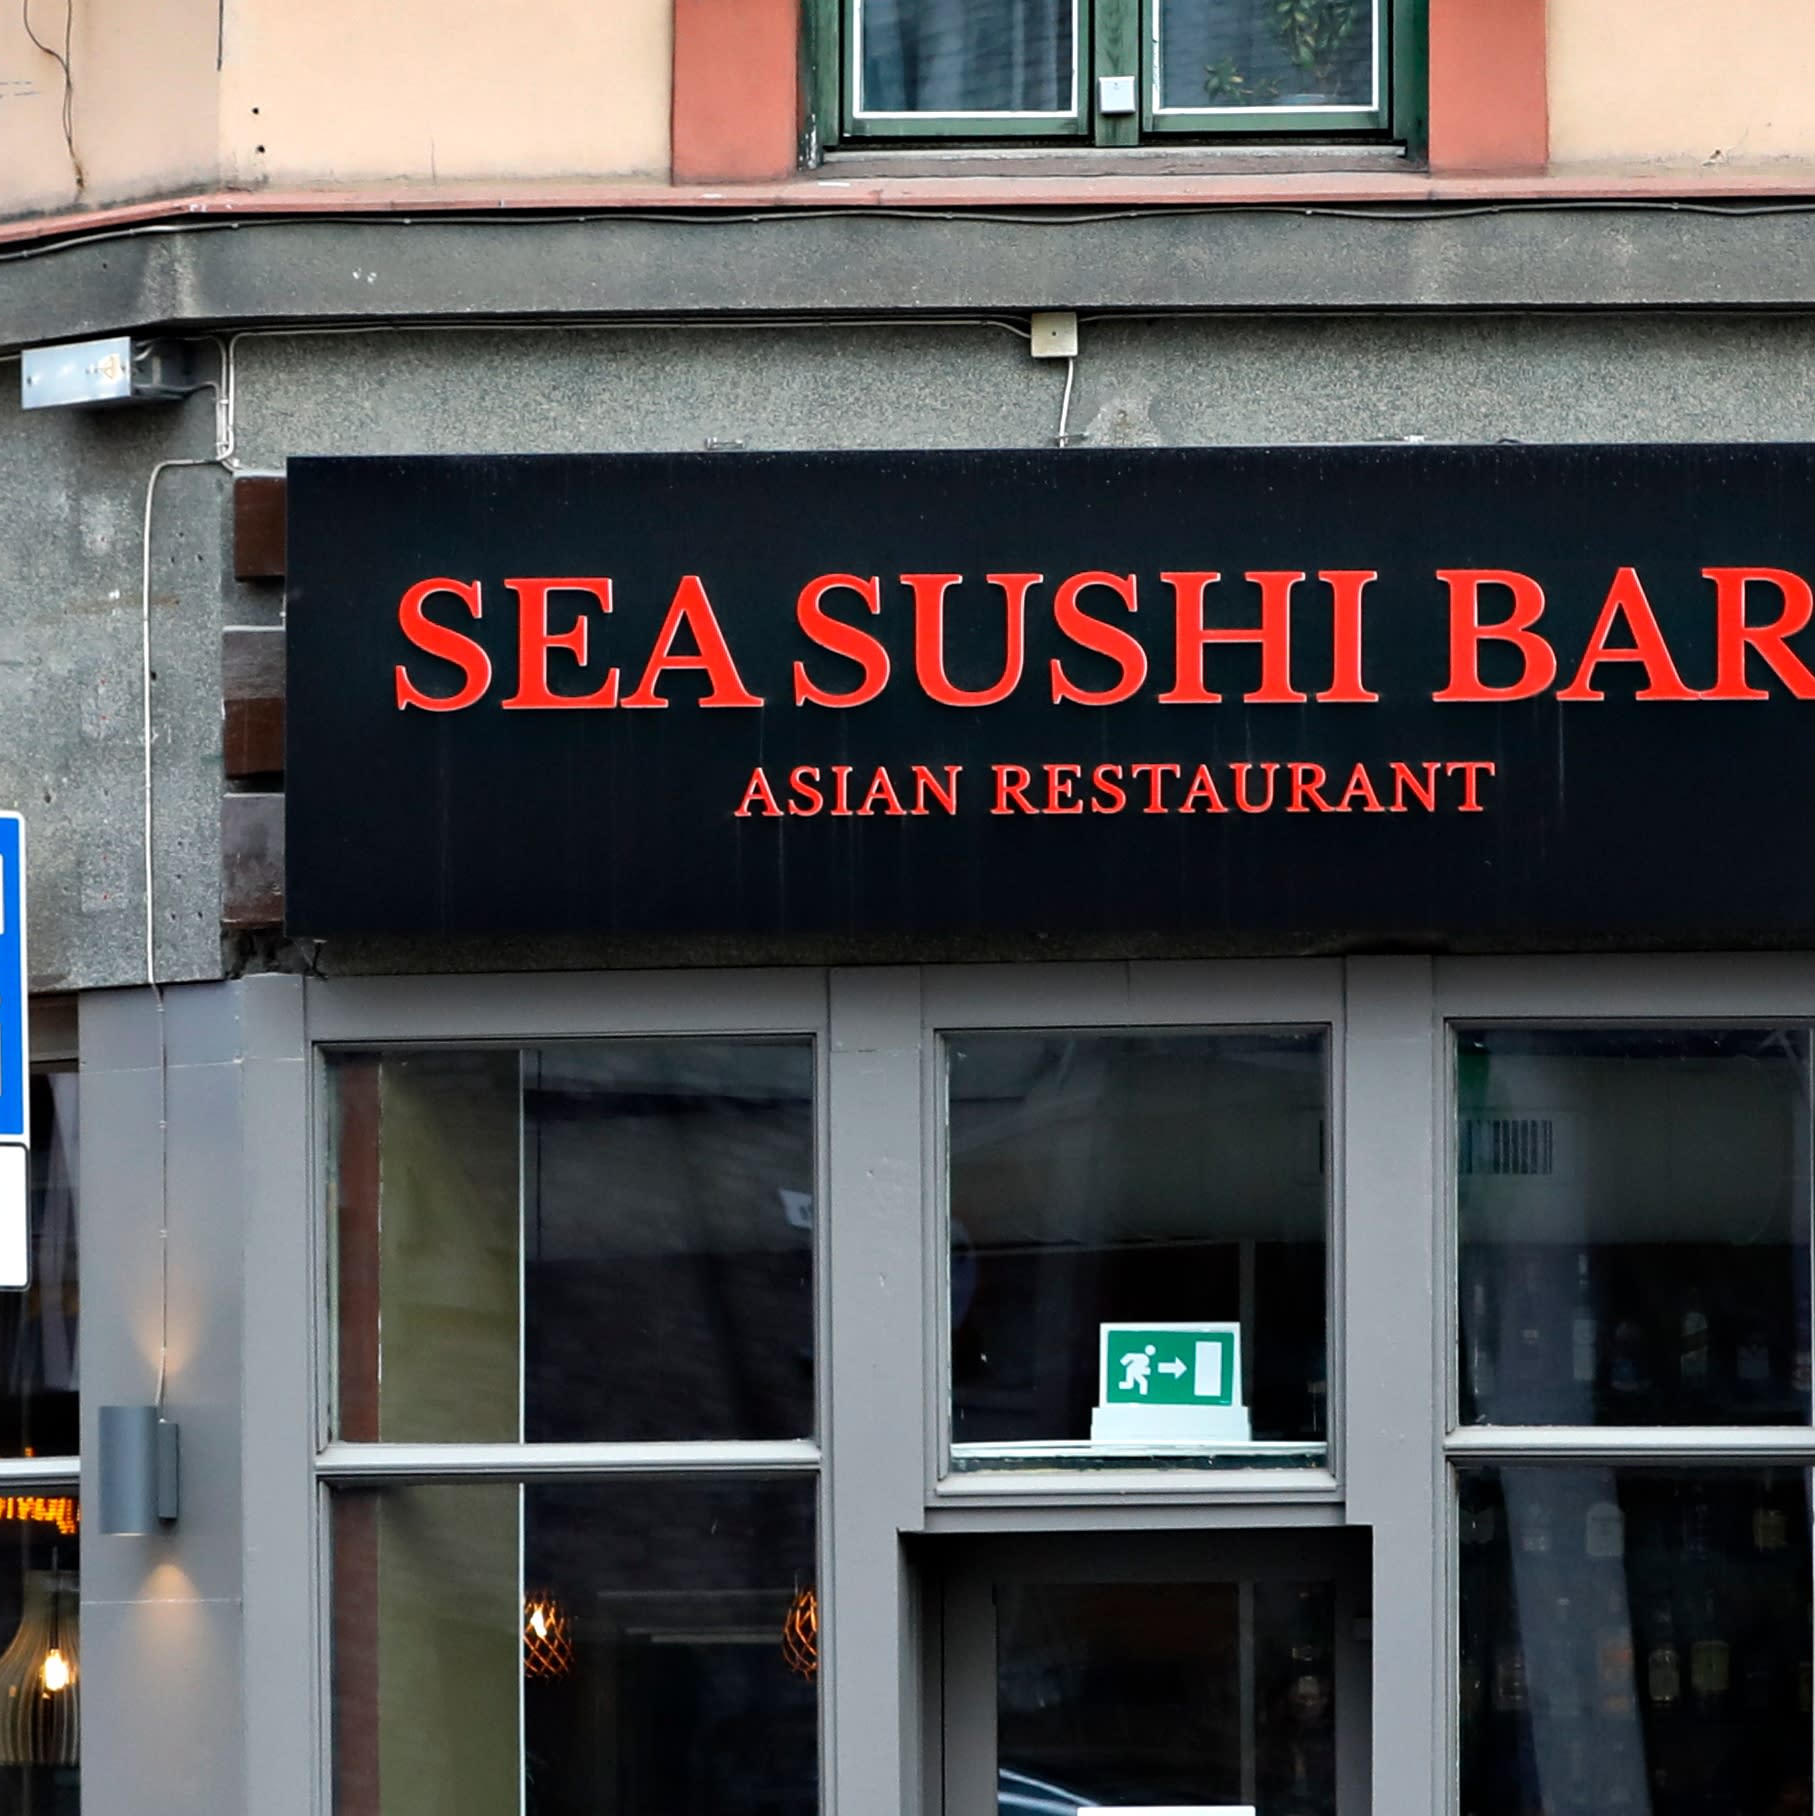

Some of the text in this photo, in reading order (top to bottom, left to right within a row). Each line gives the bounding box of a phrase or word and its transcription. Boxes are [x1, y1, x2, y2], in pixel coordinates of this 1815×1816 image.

[394, 573, 764, 713] SEA
[792, 568, 1379, 709] SUSHI
[734, 761, 1496, 818] ASIAN RESTAURANT
